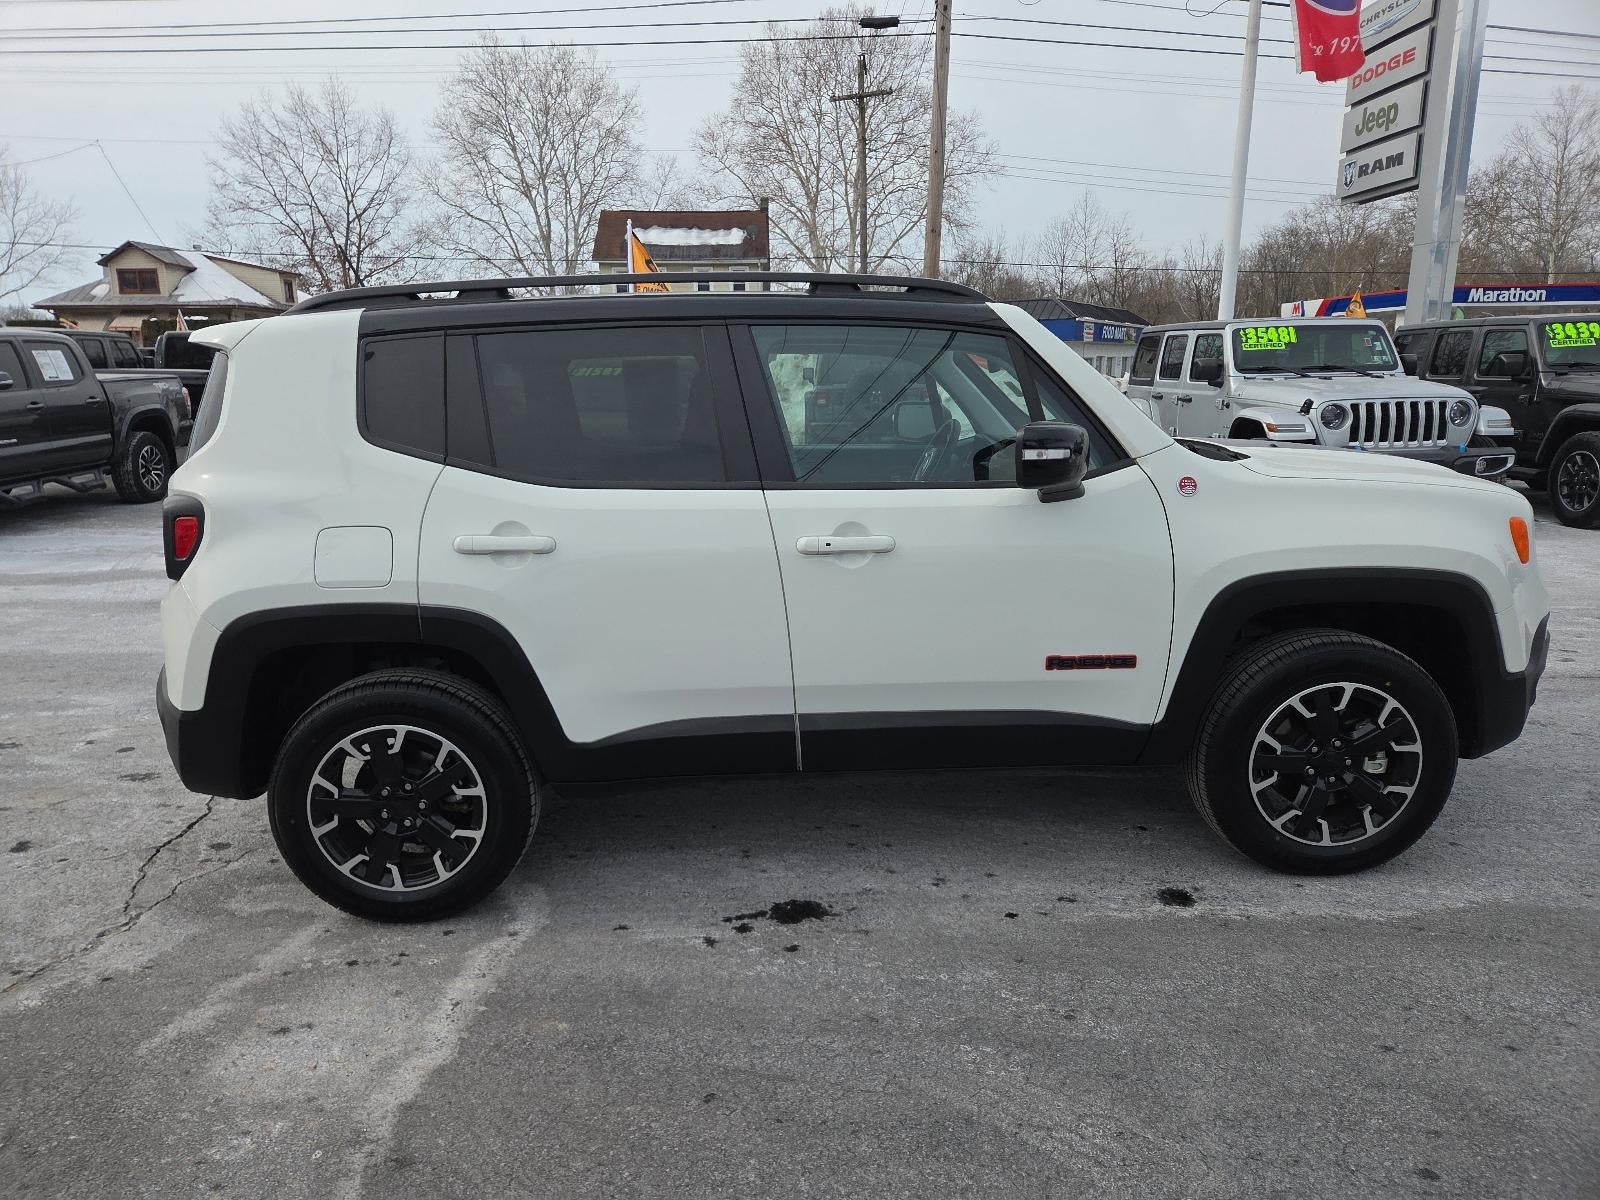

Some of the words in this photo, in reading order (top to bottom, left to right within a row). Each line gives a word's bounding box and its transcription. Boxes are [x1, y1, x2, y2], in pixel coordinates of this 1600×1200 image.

[1352, 46, 1417, 90] DODGE
[1354, 102, 1399, 136] Jeep
[1357, 151, 1404, 178] RAM
[1467, 287, 1547, 303] Marathon
[1102, 325, 1115, 339] FOOD
[1240, 326, 1297, 344] $35481
[1243, 342, 1284, 350] CERTIFIED
[1551, 338, 1593, 346] CERTIFIED
[1045, 654, 1138, 671] RENEGADE
